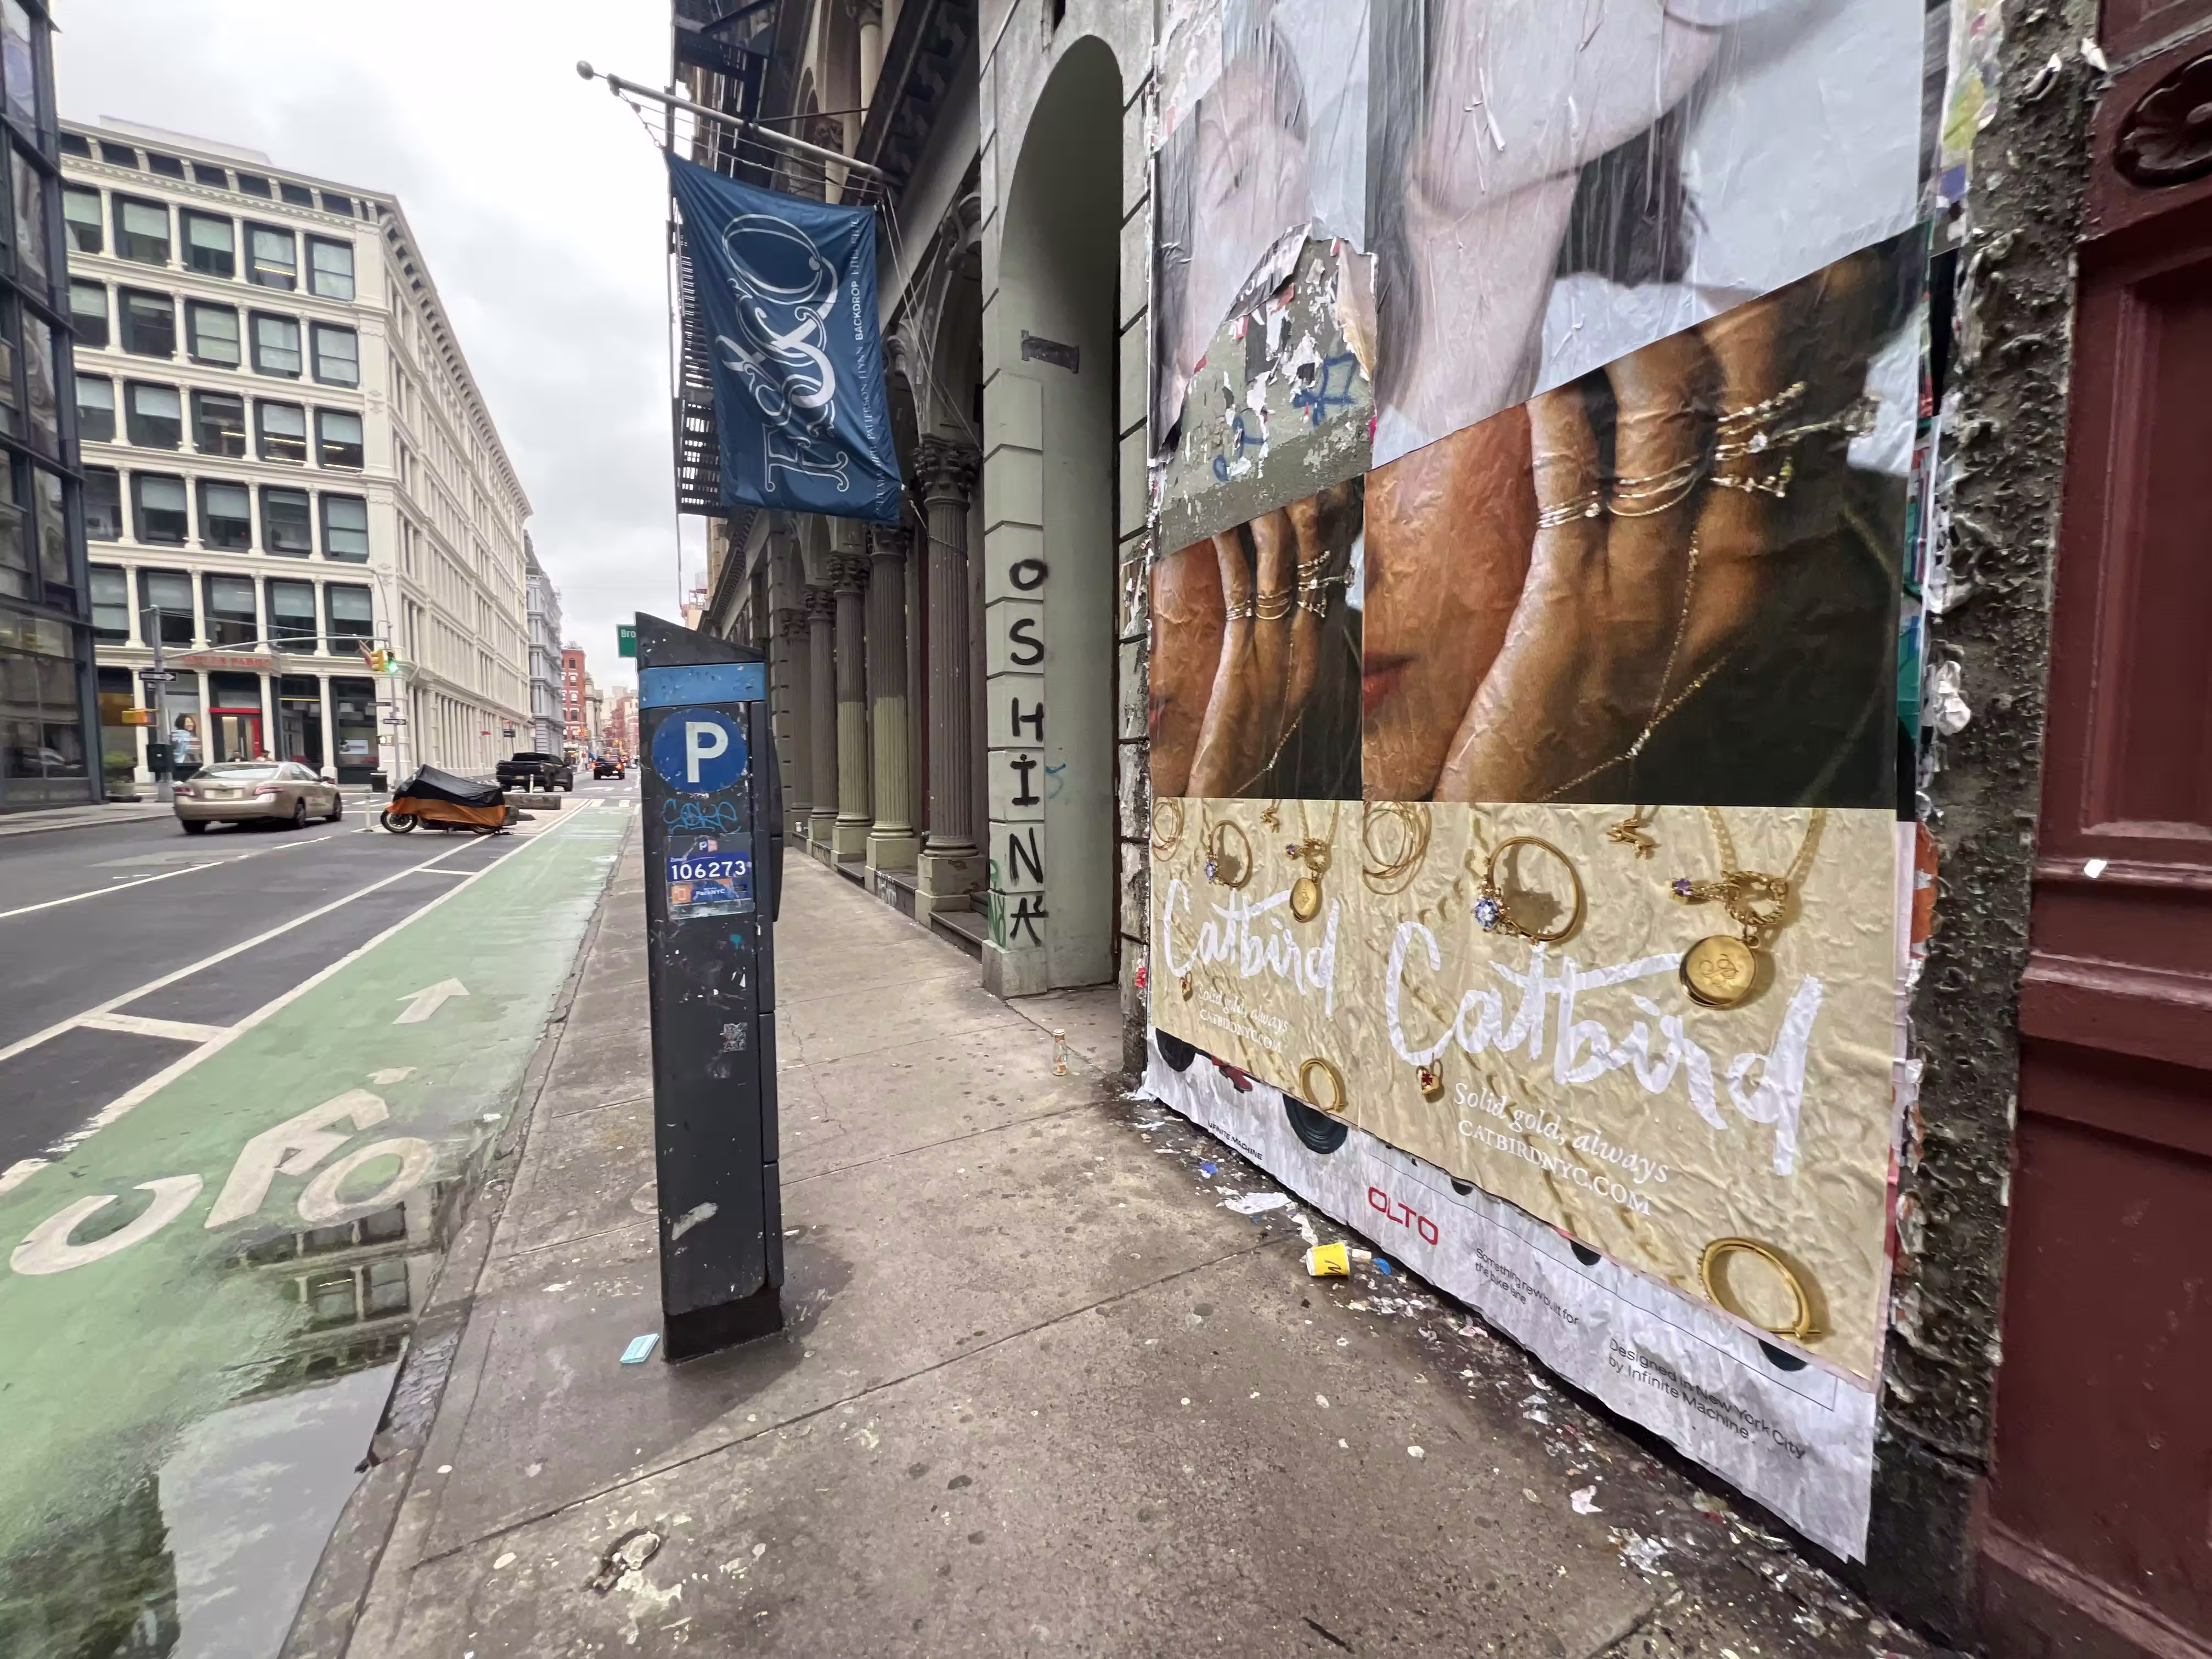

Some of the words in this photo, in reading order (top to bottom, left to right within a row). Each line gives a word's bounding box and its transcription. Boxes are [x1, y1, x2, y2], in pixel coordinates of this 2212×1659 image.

[850, 281, 864, 340] BACKDROP
[685, 722, 729, 783] P
[671, 860, 747, 881] 106273
[1164, 879, 1340, 1018] Catbird
[1198, 983, 1223, 1006] Solid
[1250, 1005, 1289, 1035] always
[1384, 921, 1824, 1176] Catbird
[1454, 1082, 1508, 1120] Solid
[1509, 1108, 1566, 1147] gold,
[1572, 1128, 1669, 1185] always
[1458, 1120, 1652, 1217] CATBIRDNYC.COM
[1368, 1186, 1438, 1245] OLTO
[1475, 1262, 1489, 1277] the
[1476, 1248, 1521, 1289] Something
[1522, 1281, 1543, 1300] new
[1562, 1309, 1579, 1325] for
[1609, 1352, 1624, 1374] by
[1628, 1365, 1679, 1399] Infinite
[1682, 1392, 1750, 1439] Machine
[1610, 1337, 1677, 1383] Designed
[1696, 1385, 1731, 1413] New
[1734, 1405, 1770, 1436] York
[1772, 1429, 1806, 1459] City
